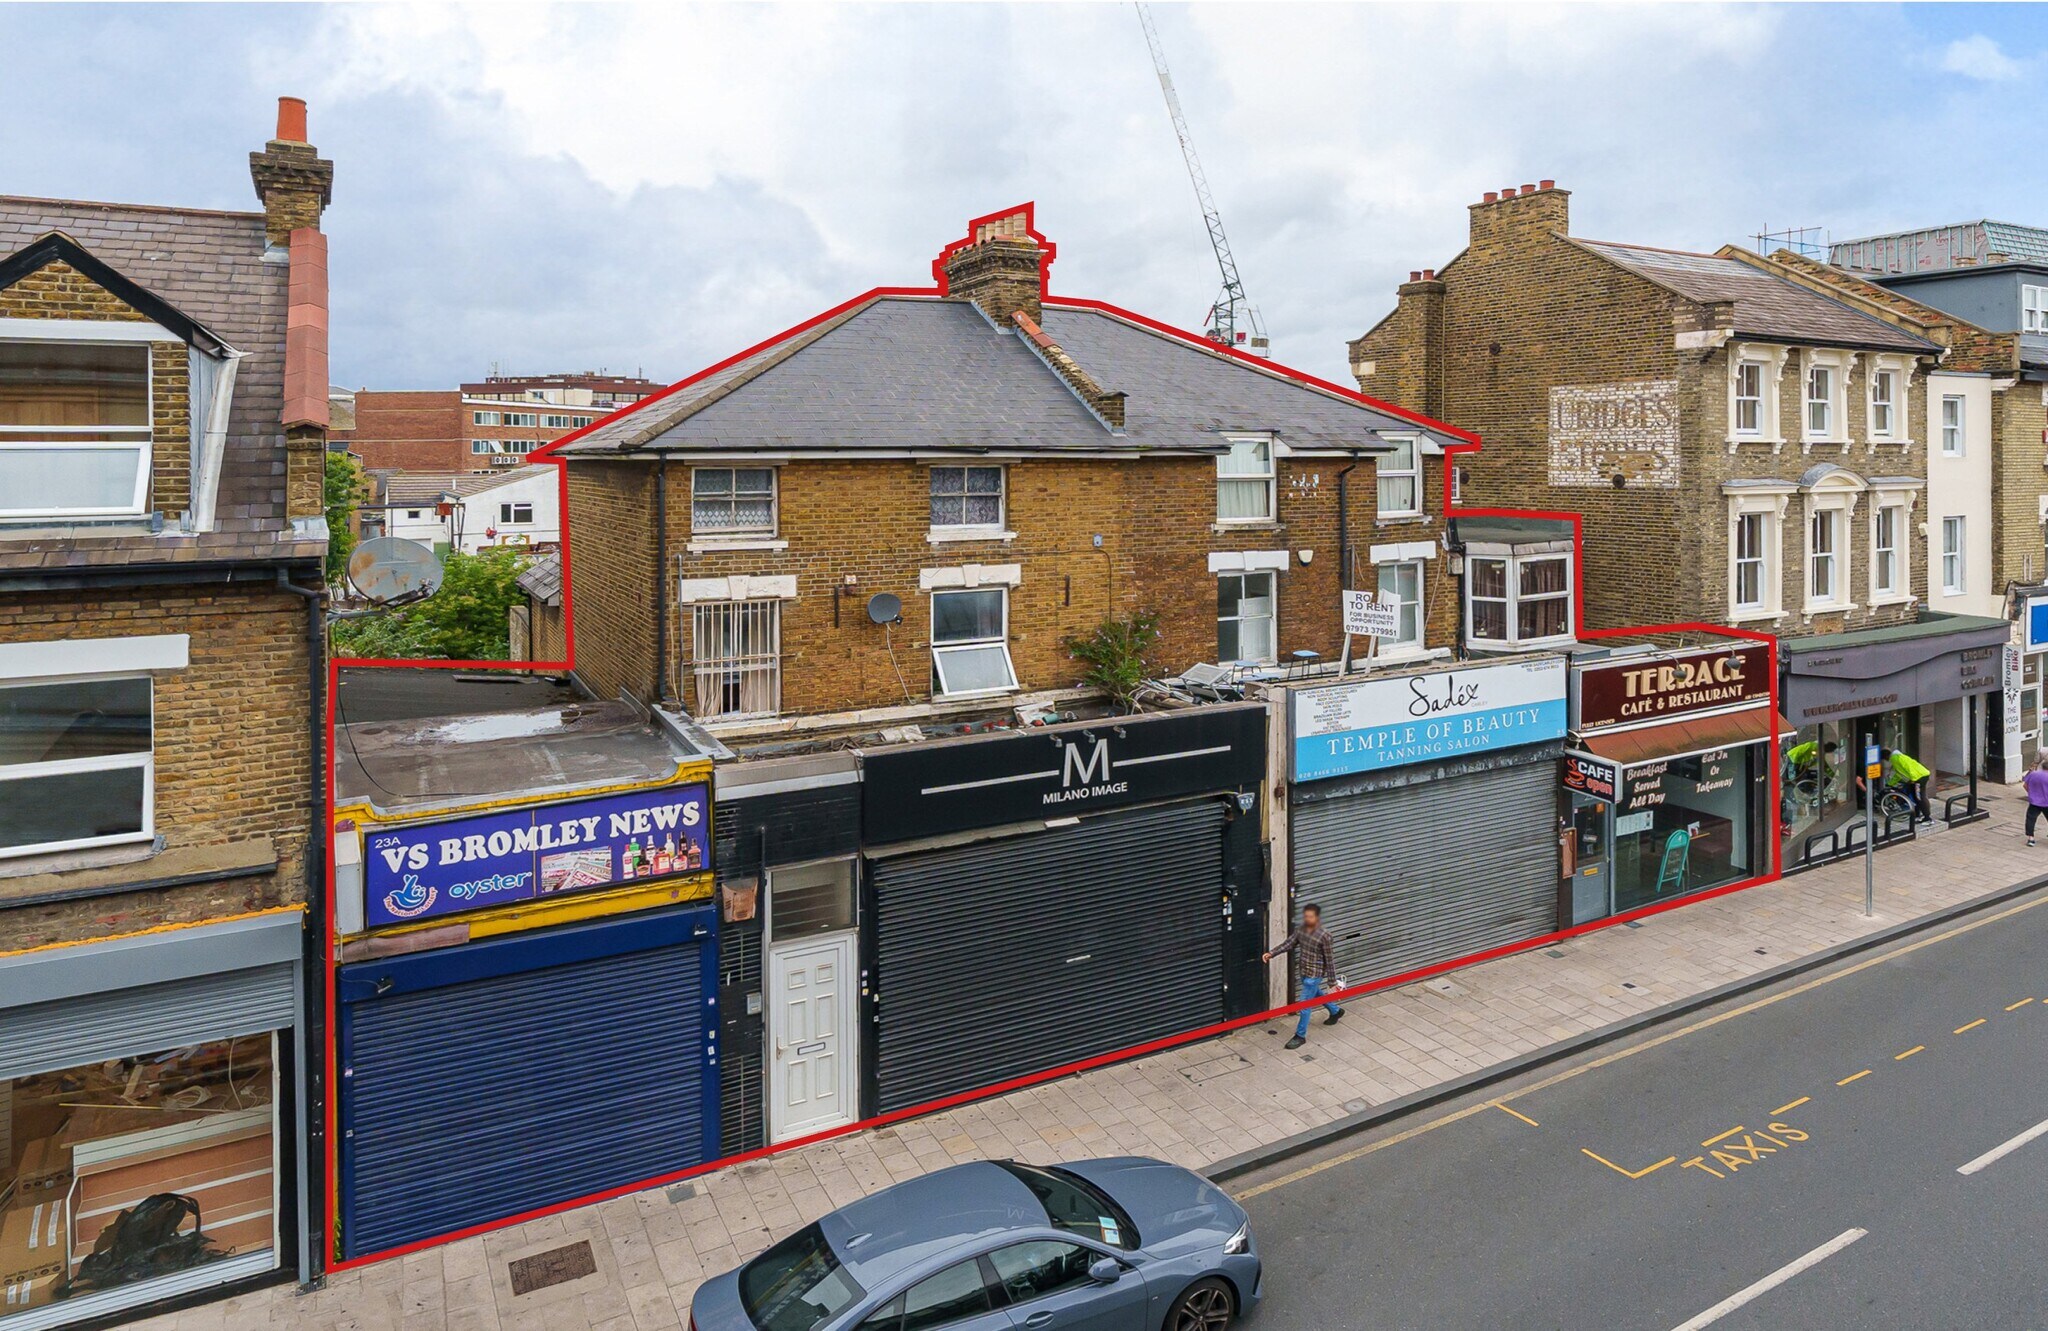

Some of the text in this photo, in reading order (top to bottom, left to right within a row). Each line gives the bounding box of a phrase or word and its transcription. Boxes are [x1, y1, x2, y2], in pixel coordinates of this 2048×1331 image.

[1349, 601, 1394, 612] TO RENT
[1363, 612, 1394, 620] BUSINESS
[1622, 655, 1746, 698] TERRACE
[2004, 646, 2012, 687] Bromley
[1409, 675, 1467, 717] Sadé
[1656, 697, 1665, 710] &
[1669, 684, 1744, 708] RESTAURANT
[2007, 706, 2017, 714] THE
[1327, 708, 1540, 756] TEMPLE OF BEAUTY
[1377, 734, 1490, 762] TANNING SALON
[1702, 750, 1728, 763] Eat In
[1063, 738, 1110, 787] M
[1578, 761, 1613, 782] CAFE
[1626, 762, 1668, 781] Breakfast
[1710, 765, 1720, 775] Or
[1043, 781, 1127, 805] MILANO IMAGE
[1586, 778, 1613, 795] open
[1634, 777, 1661, 793] Served
[1695, 777, 1734, 794] Takeaway
[1629, 792, 1666, 809] All Day
[375, 836, 400, 849] 23A
[381, 801, 700, 873] VS BROMLEY NEWS
[449, 872, 532, 900] oyster
[1680, 1122, 1810, 1179] TAXIS
